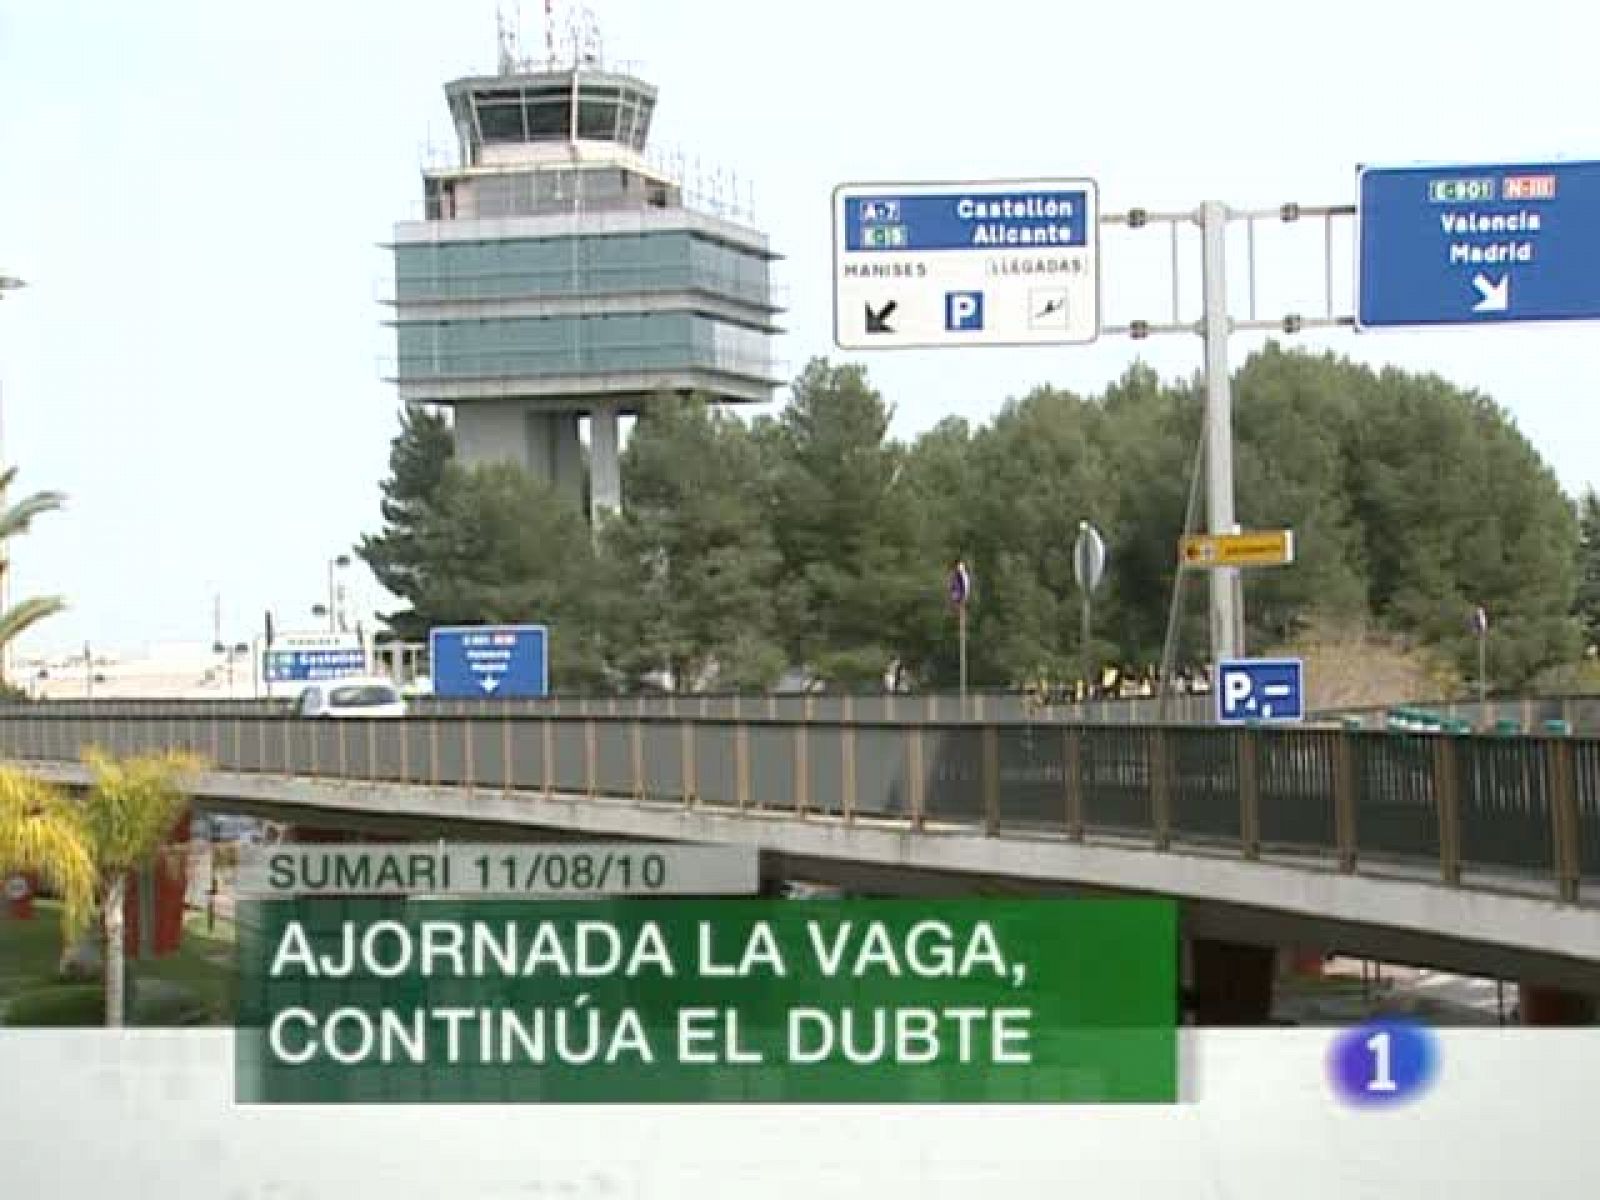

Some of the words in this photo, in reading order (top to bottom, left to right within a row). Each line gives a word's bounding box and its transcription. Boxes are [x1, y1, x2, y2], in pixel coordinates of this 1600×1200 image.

[1440, 209, 1541, 233] Valencia
[972, 223, 1072, 245] Alicante
[1450, 241, 1533, 264] Madrid
[843, 261, 928, 278] MANISES
[990, 256, 1082, 276] LLEGADAS
[951, 294, 977, 328] P
